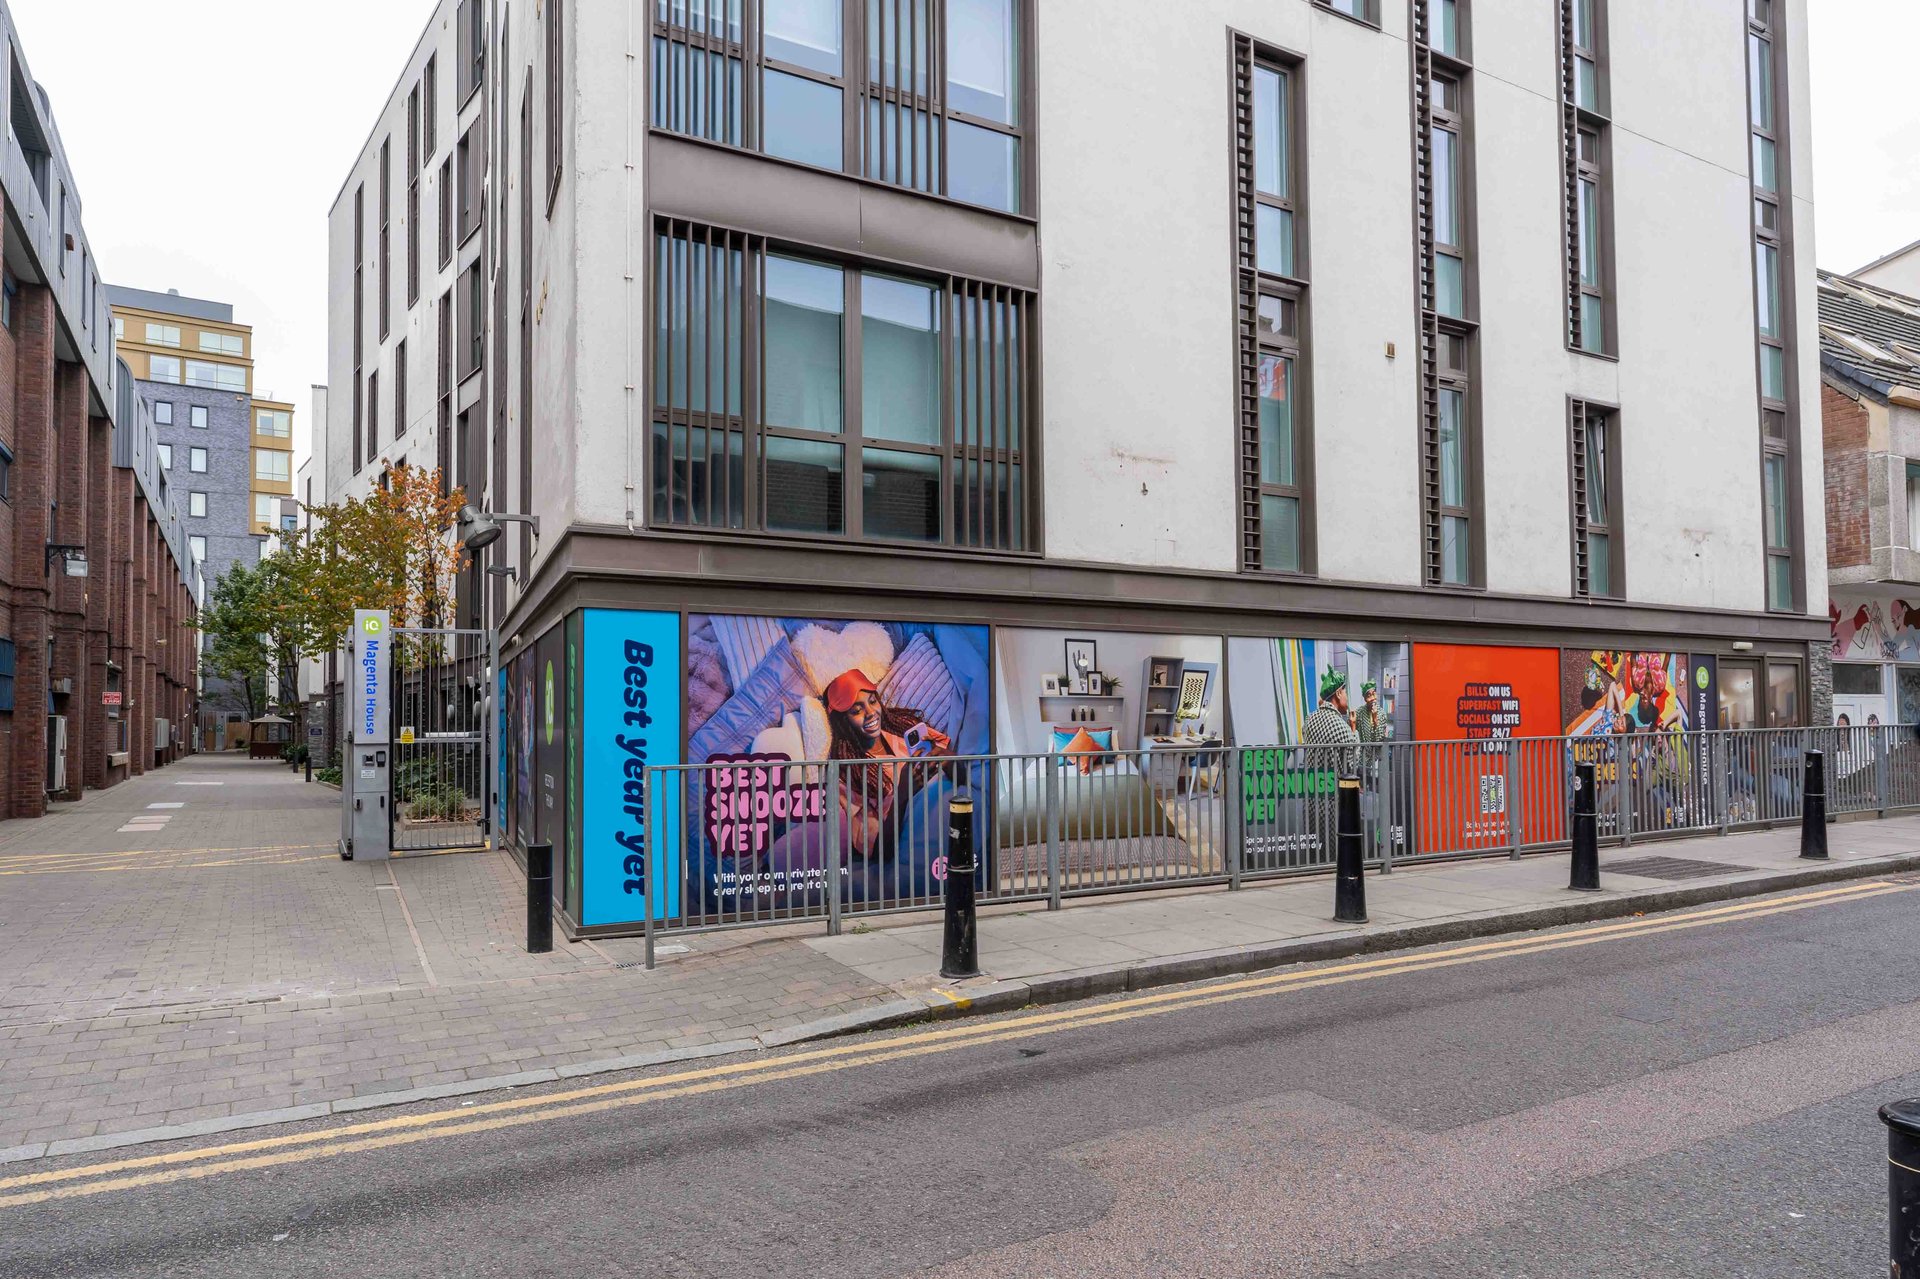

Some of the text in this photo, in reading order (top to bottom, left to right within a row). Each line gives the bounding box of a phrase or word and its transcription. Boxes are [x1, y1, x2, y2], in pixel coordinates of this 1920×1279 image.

[365, 620, 379, 631] iQ
[363, 641, 379, 735] Magenta House
[1467, 686, 1510, 697] BILLS ON US
[1459, 700, 1518, 711] SUPERFAST WIFI
[1459, 714, 1519, 724] SOCIALS ON SITE
[1469, 728, 1510, 739] STAFF 24/7
[615, 639, 653, 895] Best year yet
[1244, 749, 1284, 771] BEST
[711, 759, 785, 788] BEST
[1245, 771, 1335, 796] MORNINGS
[711, 789, 826, 820] SNOOZE
[1245, 798, 1275, 821] YET
[711, 822, 768, 853] YET
[713, 872, 736, 883] With
[764, 872, 784, 880] own
[823, 867, 849, 876] rm,
[745, 883, 776, 895] sleps
